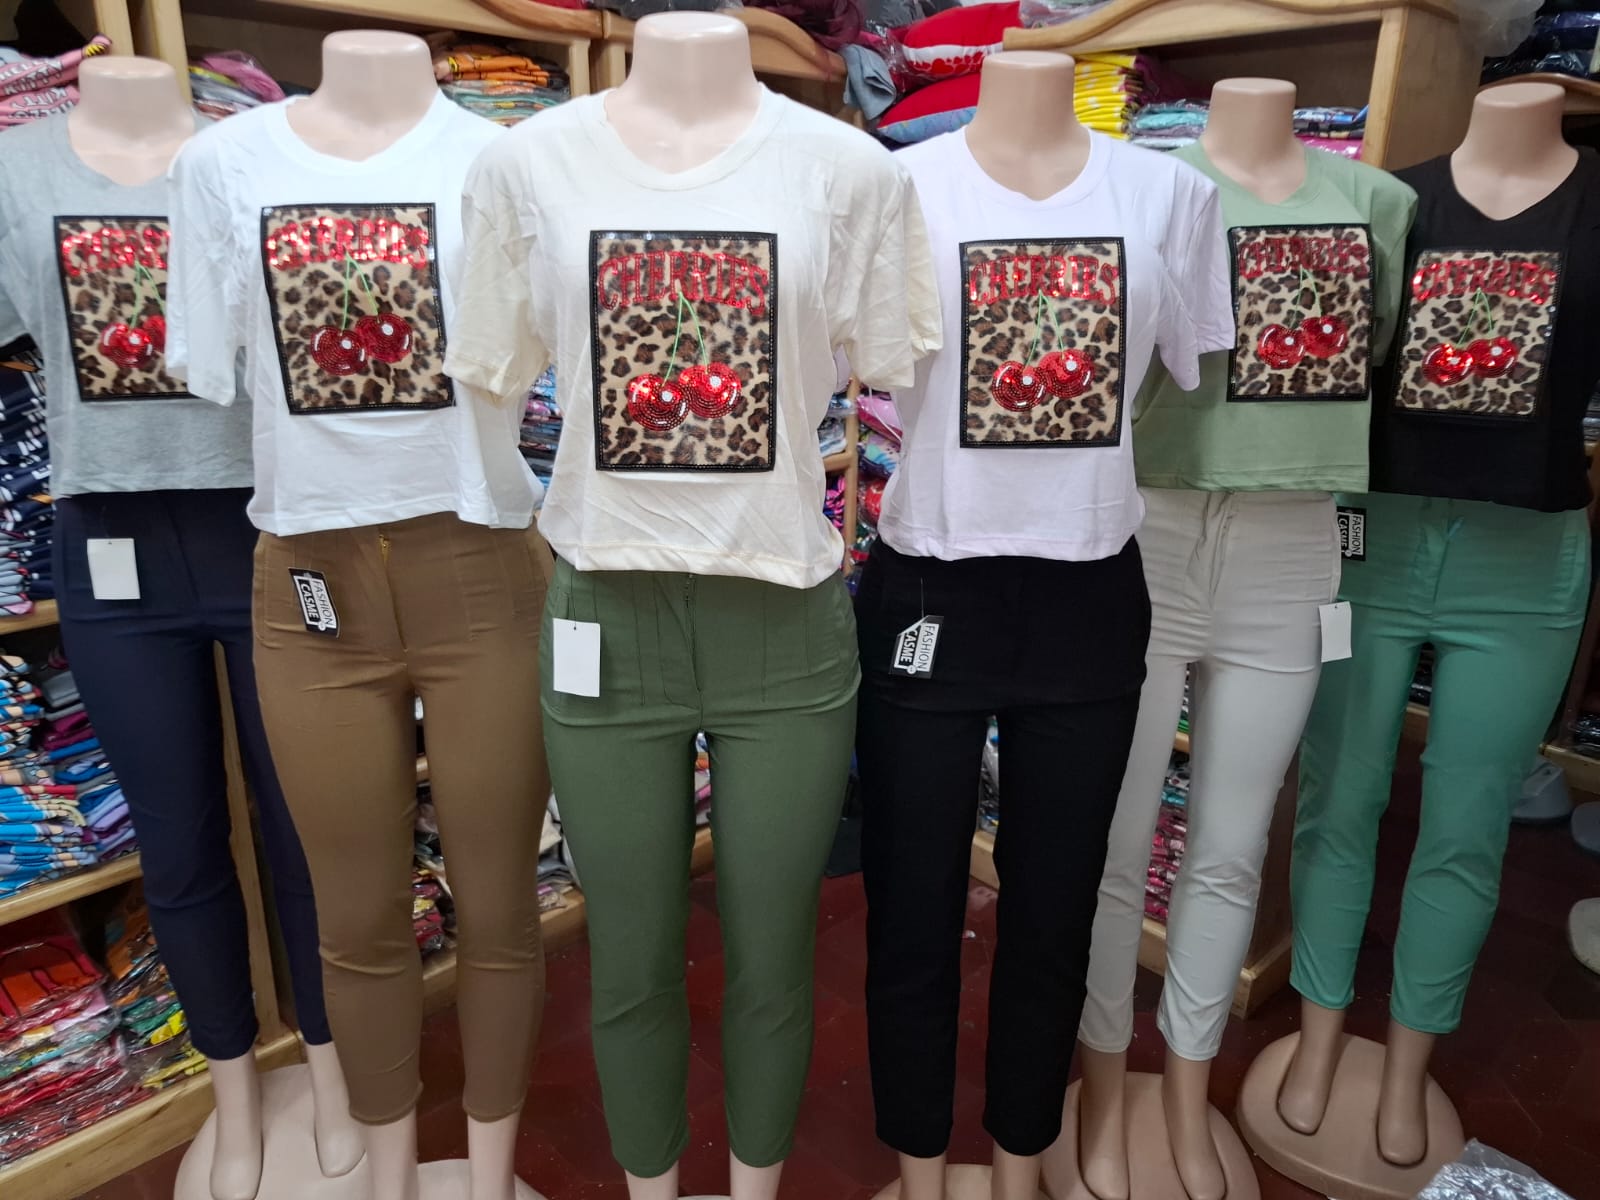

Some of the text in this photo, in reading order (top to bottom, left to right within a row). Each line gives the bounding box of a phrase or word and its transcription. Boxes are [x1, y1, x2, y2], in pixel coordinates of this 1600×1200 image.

[267, 217, 428, 270] CHERRIES
[1238, 236, 1369, 282] CHERRIES
[597, 249, 769, 315] CHERRIES
[968, 254, 1120, 306] CHERRIES
[1412, 259, 1557, 305] CHERRIES
[1351, 515, 1362, 554] FASHION
[300, 583, 320, 619] CASME
[311, 580, 336, 626] FASHION
[900, 629, 918, 663] CASME
[917, 625, 936, 669] FASHION
